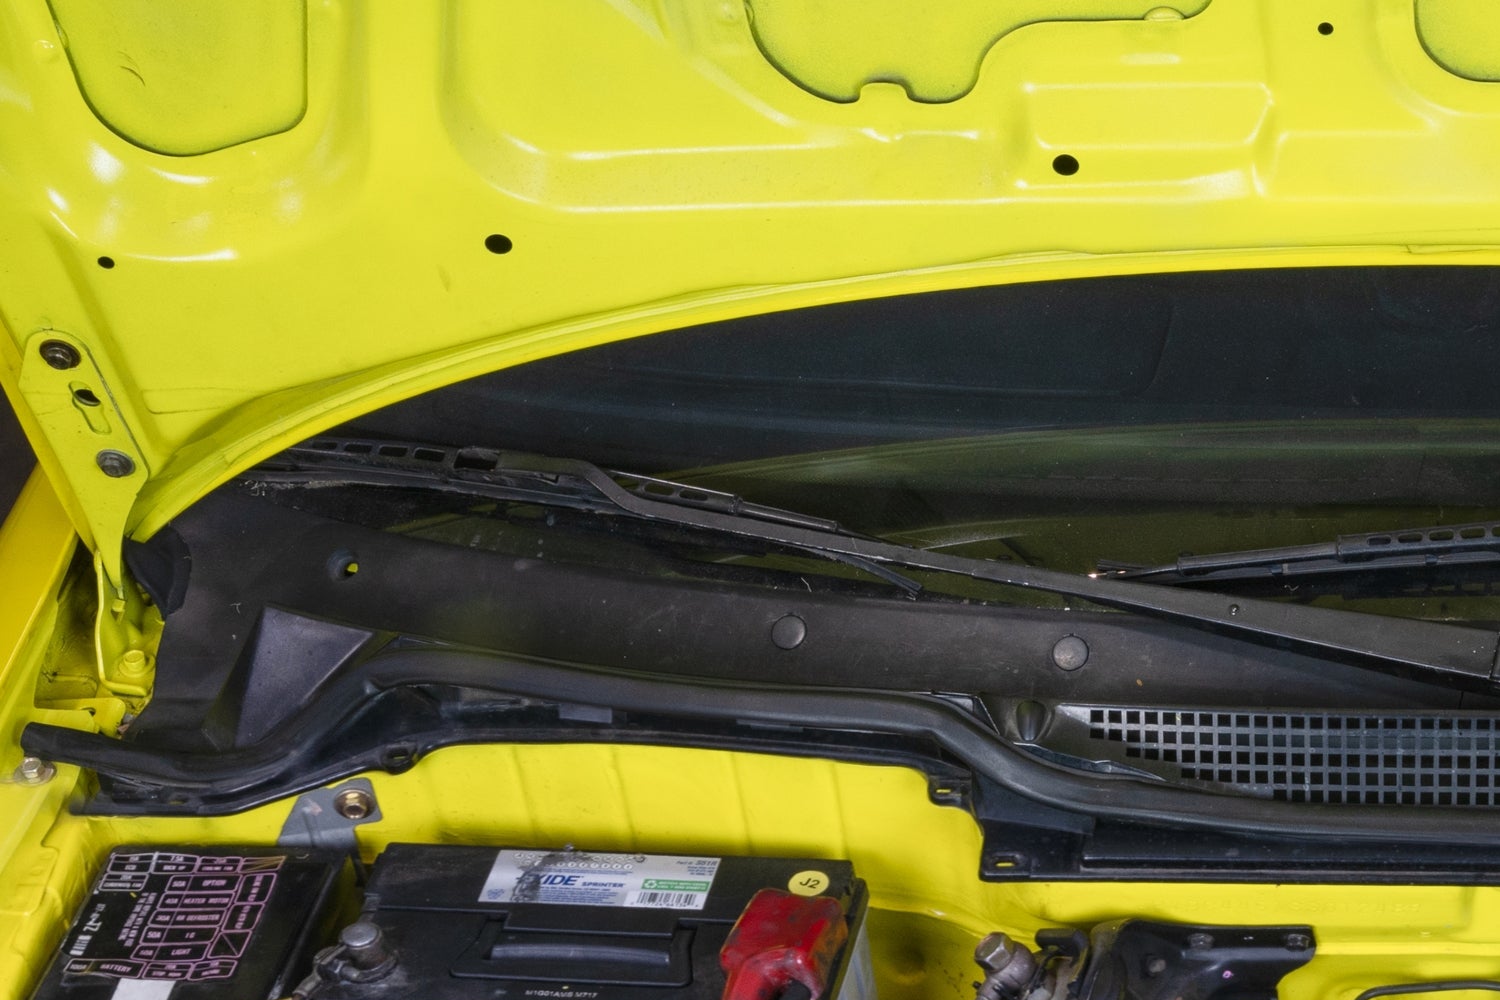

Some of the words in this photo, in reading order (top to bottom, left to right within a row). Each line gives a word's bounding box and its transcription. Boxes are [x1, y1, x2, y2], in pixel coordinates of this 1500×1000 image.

[202, 879, 227, 887] OPTION
[799, 878, 820, 889] J2
[171, 948, 192, 956] LIGHT
[101, 963, 132, 972] BATTERY
